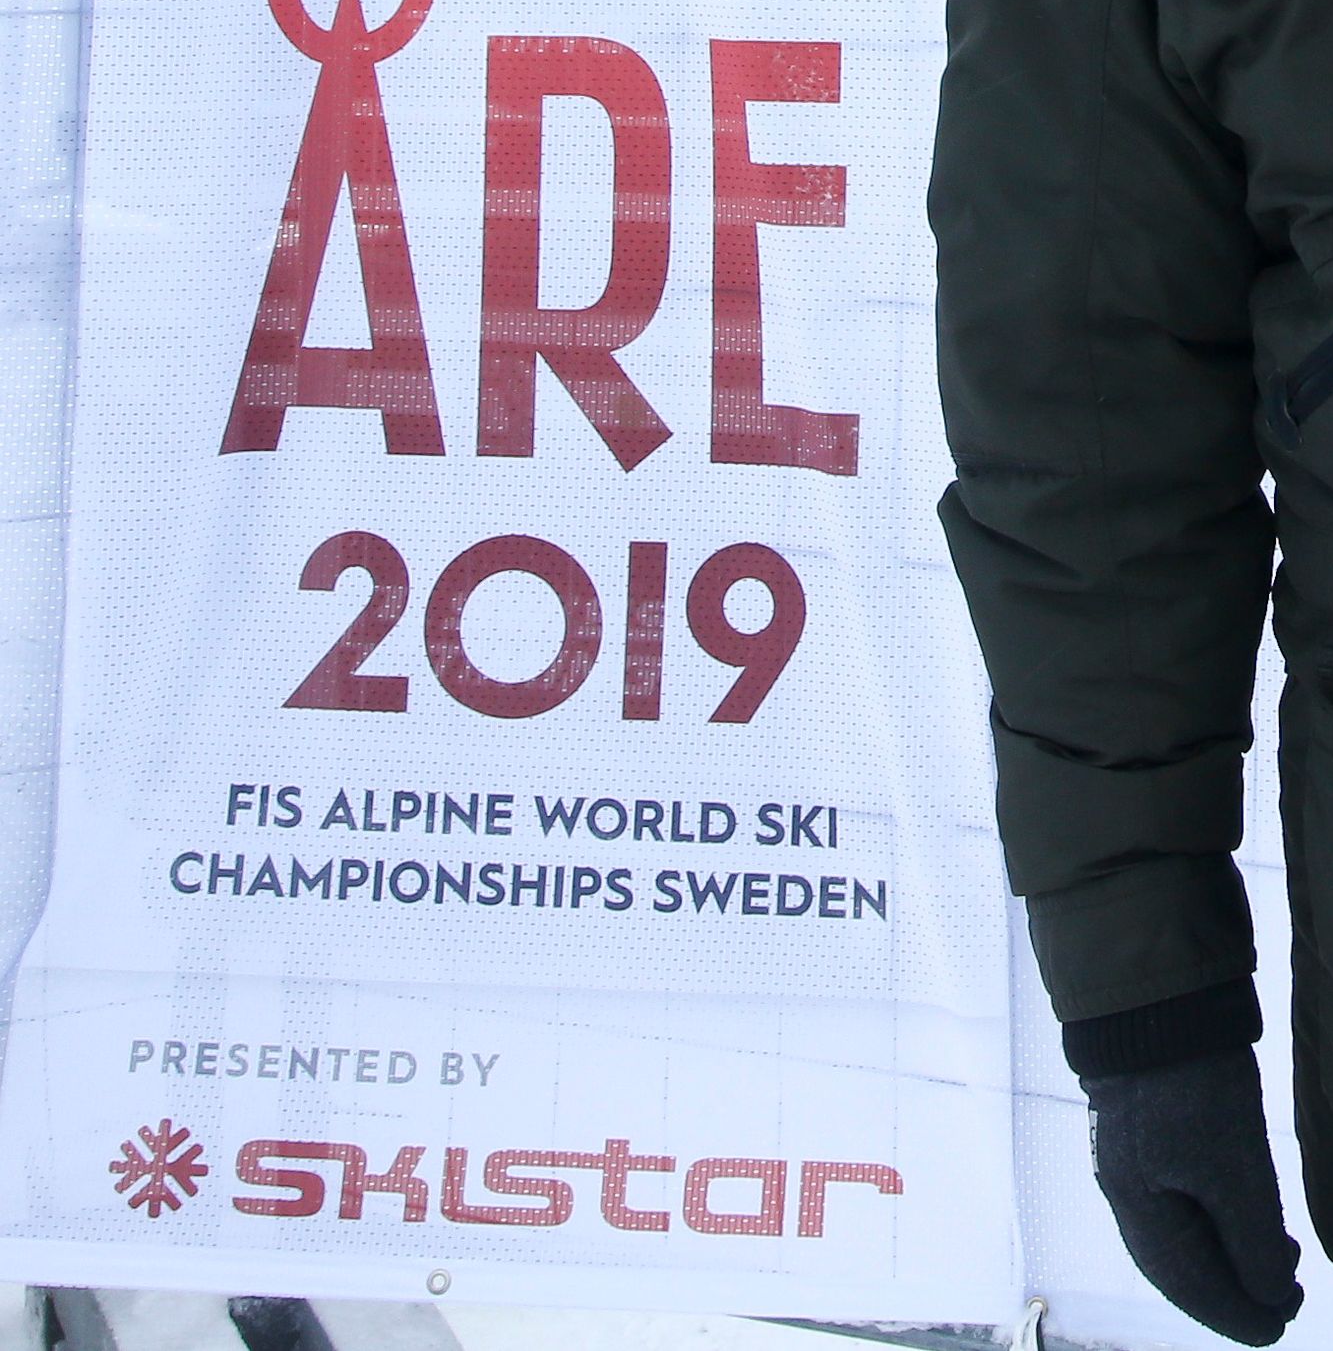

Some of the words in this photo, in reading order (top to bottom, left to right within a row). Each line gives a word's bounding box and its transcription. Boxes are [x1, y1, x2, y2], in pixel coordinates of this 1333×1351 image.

[281, 530, 807, 724] 2019
[225, 783, 304, 830] FIS
[320, 788, 516, 837] ALPINE
[533, 793, 737, 844] WORLD
[754, 802, 840, 850] SKI
[168, 851, 635, 912] CHAMPIONSHIPS
[651, 869, 890, 922] SWEDEN
[128, 1039, 418, 1086] PRESENTED
[439, 1053, 502, 1088] BY
